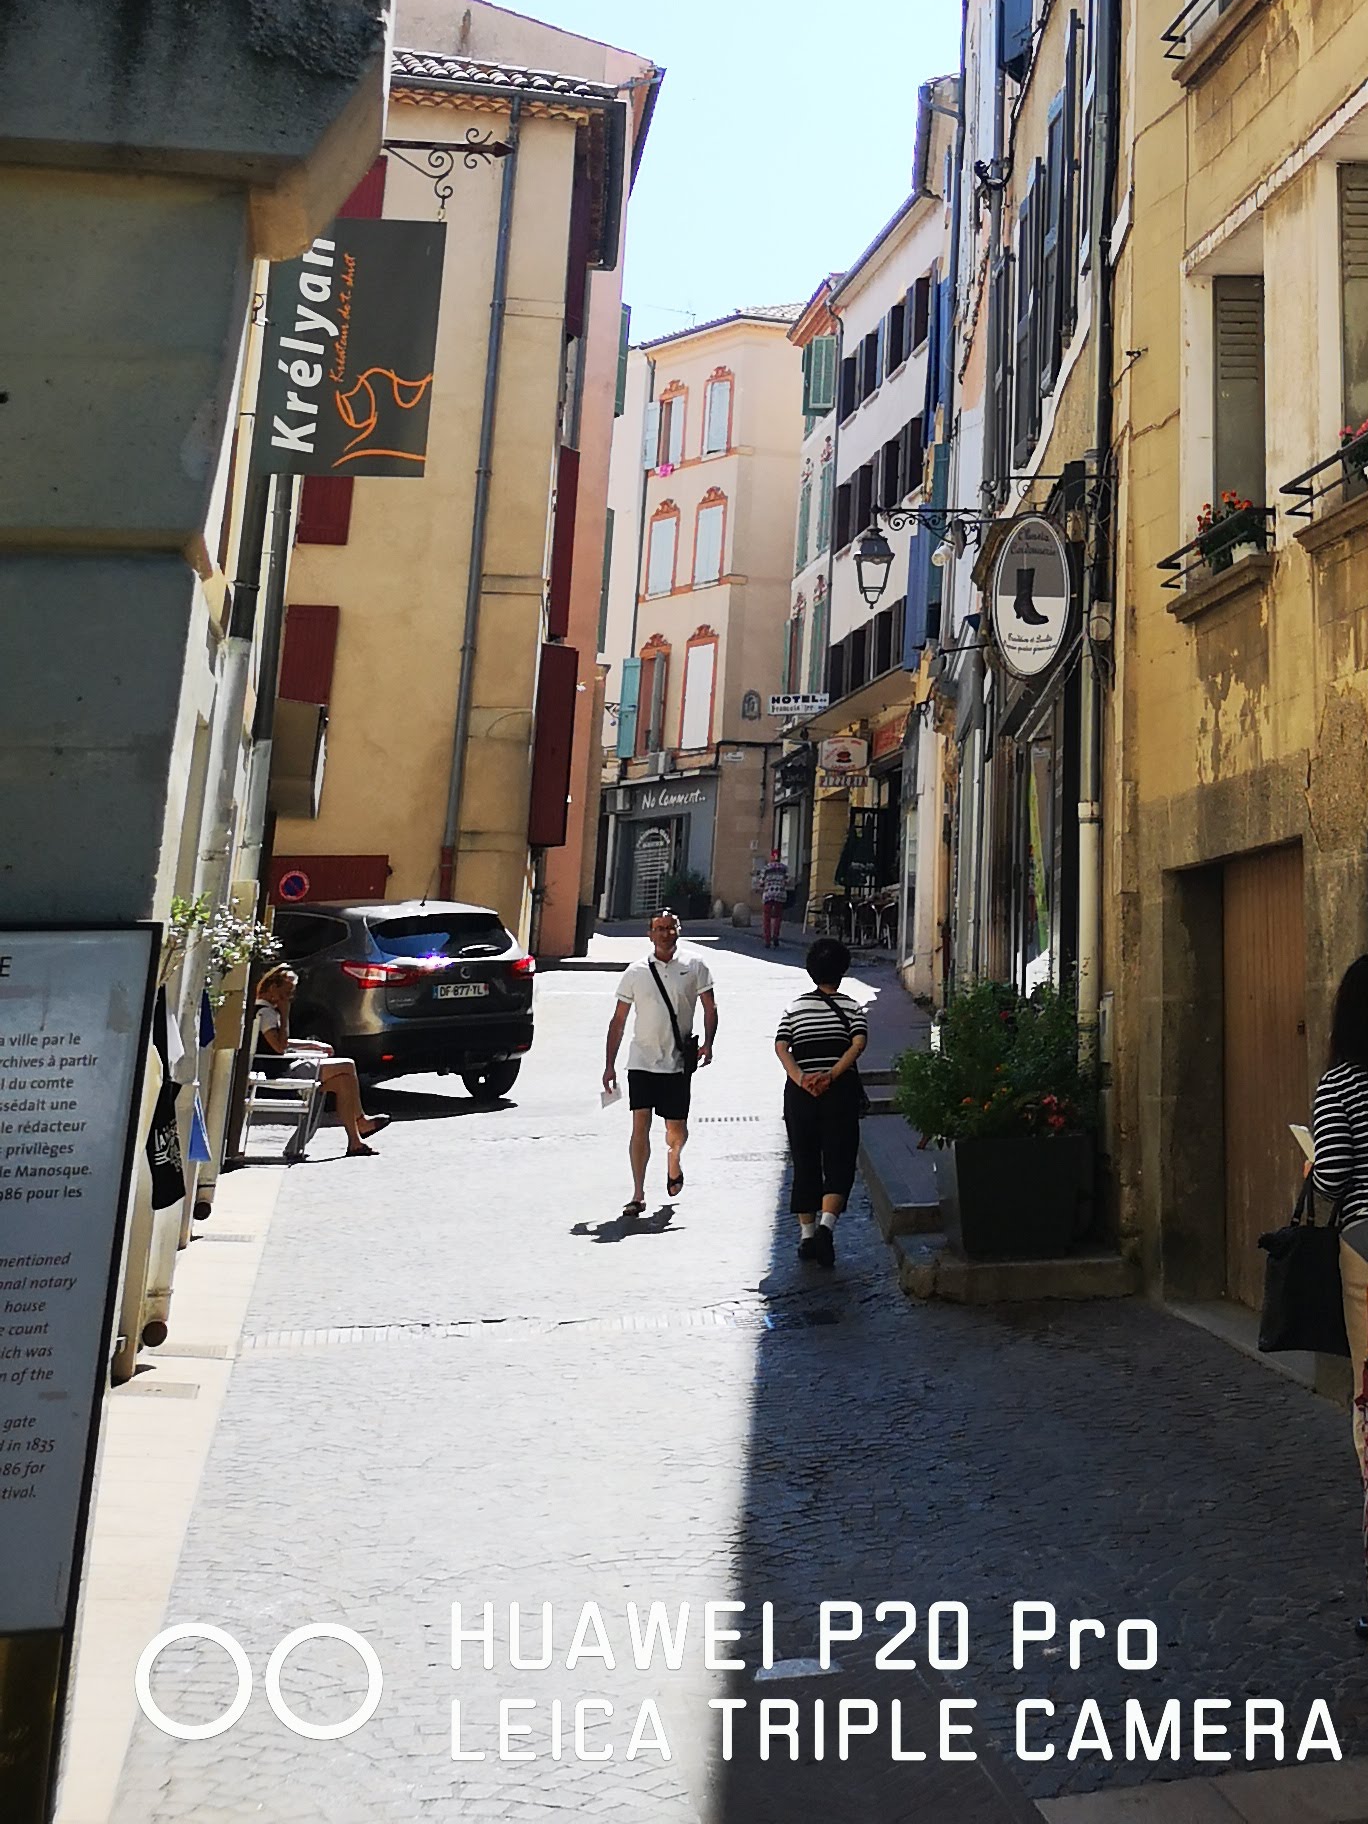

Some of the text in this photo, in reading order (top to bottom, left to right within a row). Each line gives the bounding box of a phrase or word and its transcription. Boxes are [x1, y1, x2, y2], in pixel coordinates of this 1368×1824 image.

[270, 238, 339, 454] Krélyan
[771, 695, 819, 704] HOTEL
[641, 789, 656, 810] No
[10, 1034, 38, 1047] ville
[42, 1035, 65, 1049] par
[69, 1033, 81, 1045] le
[47, 1054, 56, 1067] à
[60, 1055, 98, 1070] partir
[8, 1077, 26, 1090] du
[30, 1077, 74, 1090] comte
[50, 1100, 77, 1111] une
[17, 1120, 87, 1134] rédacteur
[5, 1142, 74, 1159] privilèges
[15, 1163, 92, 1181] Manosque.
[26, 1189, 60, 1204] pour
[63, 1185, 83, 1199] les
[30, 1276, 77, 1291] notary
[4, 1300, 46, 1313] house
[8, 1323, 49, 1336] count
[25, 1346, 54, 1358] was
[11, 1367, 29, 1385] of
[30, 1367, 54, 1380] the
[3, 1415, 37, 1433] gate
[7, 1439, 22, 1452] in
[26, 1437, 55, 1453] 1835
[0, 1460, 46, 1478] 86 for
